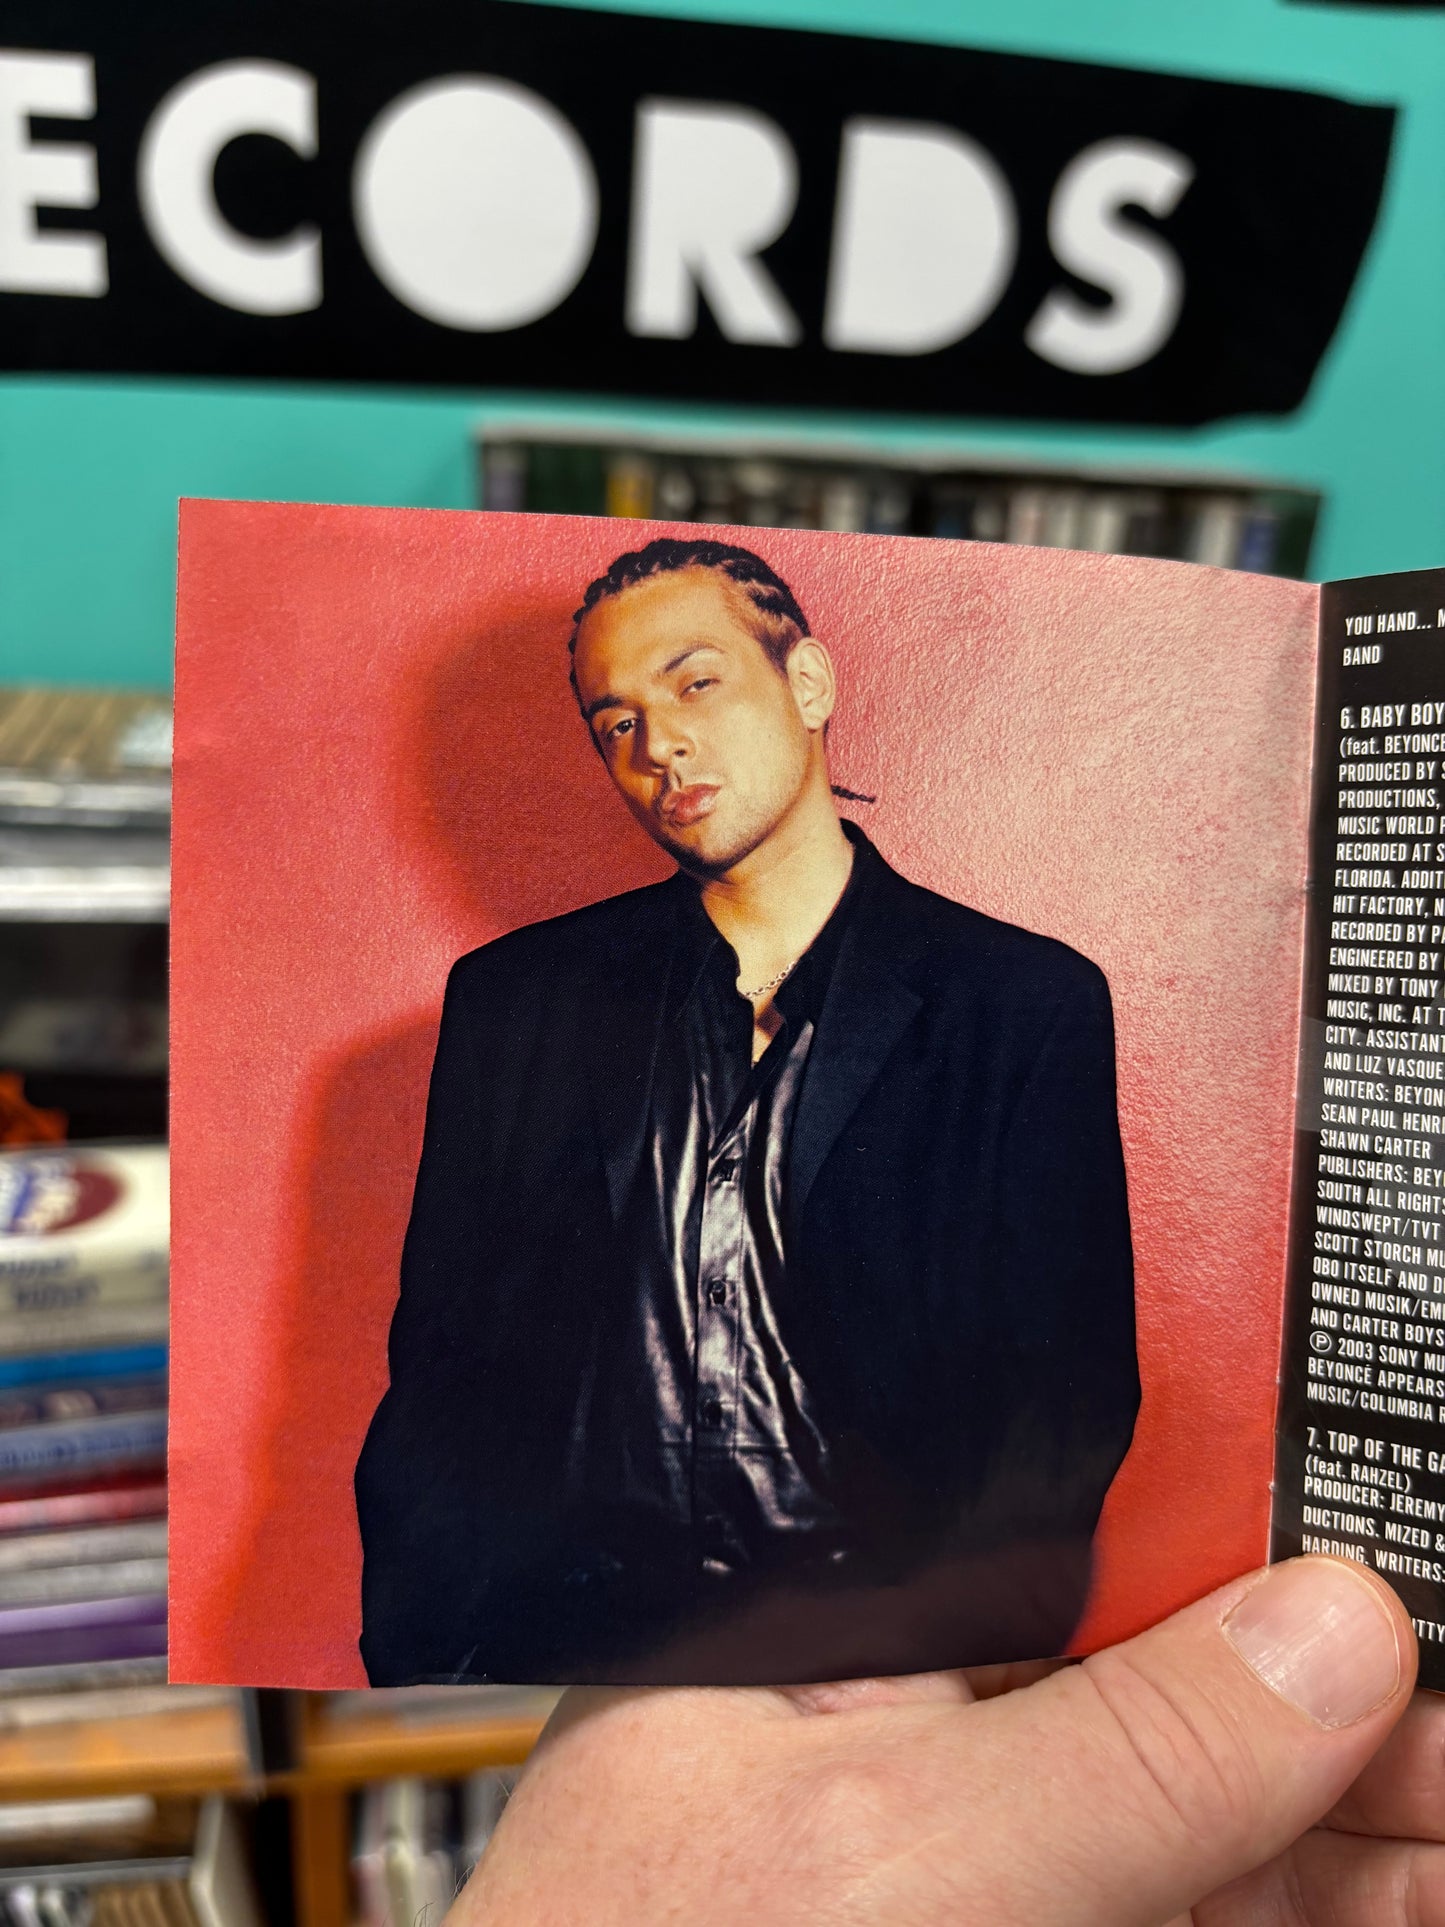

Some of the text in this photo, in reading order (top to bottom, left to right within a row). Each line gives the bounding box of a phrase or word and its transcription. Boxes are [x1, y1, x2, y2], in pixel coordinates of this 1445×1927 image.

[0, 48, 1194, 376] ECORDS
[1345, 616, 1372, 636] YOU
[1377, 612, 1431, 634] HAND...
[1343, 646, 1380, 666] BAND
[1340, 702, 1445, 729] 6. BABY BOY
[1340, 738, 1380, 758] (feat.
[1339, 763, 1410, 782] PRODUCED
[1416, 762, 1436, 780] BY
[1338, 789, 1440, 809] PRODUCTIONS,
[1338, 816, 1380, 835] MUSIC
[1386, 816, 1434, 835] WORLD
[1336, 843, 1406, 861] RECORDED
[1412, 844, 1431, 862] AT
[1334, 869, 1445, 889] FLORIDA. ADDIT
[1333, 895, 1357, 913] HIT
[1360, 896, 1428, 918] FACTORY,
[1331, 921, 1401, 942] RECORDED
[1406, 924, 1427, 943] BY
[1329, 948, 1438, 971] ENGINEERED BY
[1328, 973, 1438, 998] MIXED BY TONY
[1327, 999, 1373, 1023] MUSIC,
[1378, 1003, 1406, 1023] INC.
[1412, 1006, 1432, 1024] AT
[1325, 1025, 1360, 1046] CITY.
[1324, 1051, 1445, 1080] AND LUZ VASQUE
[1323, 1077, 1445, 1107] WRITERS: BEYON
[1321, 1103, 1356, 1125] SEAN
[1361, 1108, 1397, 1129] PAUL
[1320, 1129, 1431, 1160] SHAWN CARTER
[1318, 1154, 1445, 1188] PUBLISHERS: BEY
[1317, 1180, 1361, 1203] SOUTH
[1366, 1188, 1392, 1208] ALL
[1316, 1205, 1441, 1241] WINDSWEPT/TVT
[1314, 1231, 1359, 1253] SCOTT
[1364, 1239, 1421, 1265] STORCH
[1313, 1256, 1339, 1277] OBO
[1344, 1262, 1393, 1286] ITSELF
[1398, 1270, 1427, 1291] AND
[1311, 1281, 1360, 1307] OWNED
[1310, 1306, 1445, 1347] AND CARTER BOYS
[1338, 1338, 1373, 1360] 2003
[1379, 1345, 1418, 1368] SONY
[1307, 1356, 1445, 1398] BEYONCÉ APPEARS
[1307, 1381, 1432, 1420] MUSIC/COLUMBIA
[1307, 1427, 1321, 1449] 7.
[1328, 1430, 1358, 1456] TOP
[1365, 1438, 1384, 1460] OF
[1391, 1443, 1421, 1469] THE
[1305, 1454, 1411, 1493] (feat. RAHZEL)
[1304, 1475, 1445, 1521] PRODUCER: JEREMY
[1303, 1505, 1379, 1538] DUCTIONS.
[1385, 1521, 1430, 1549] MIZED
[1302, 1534, 1445, 1583] HARDING. WRITERS:
